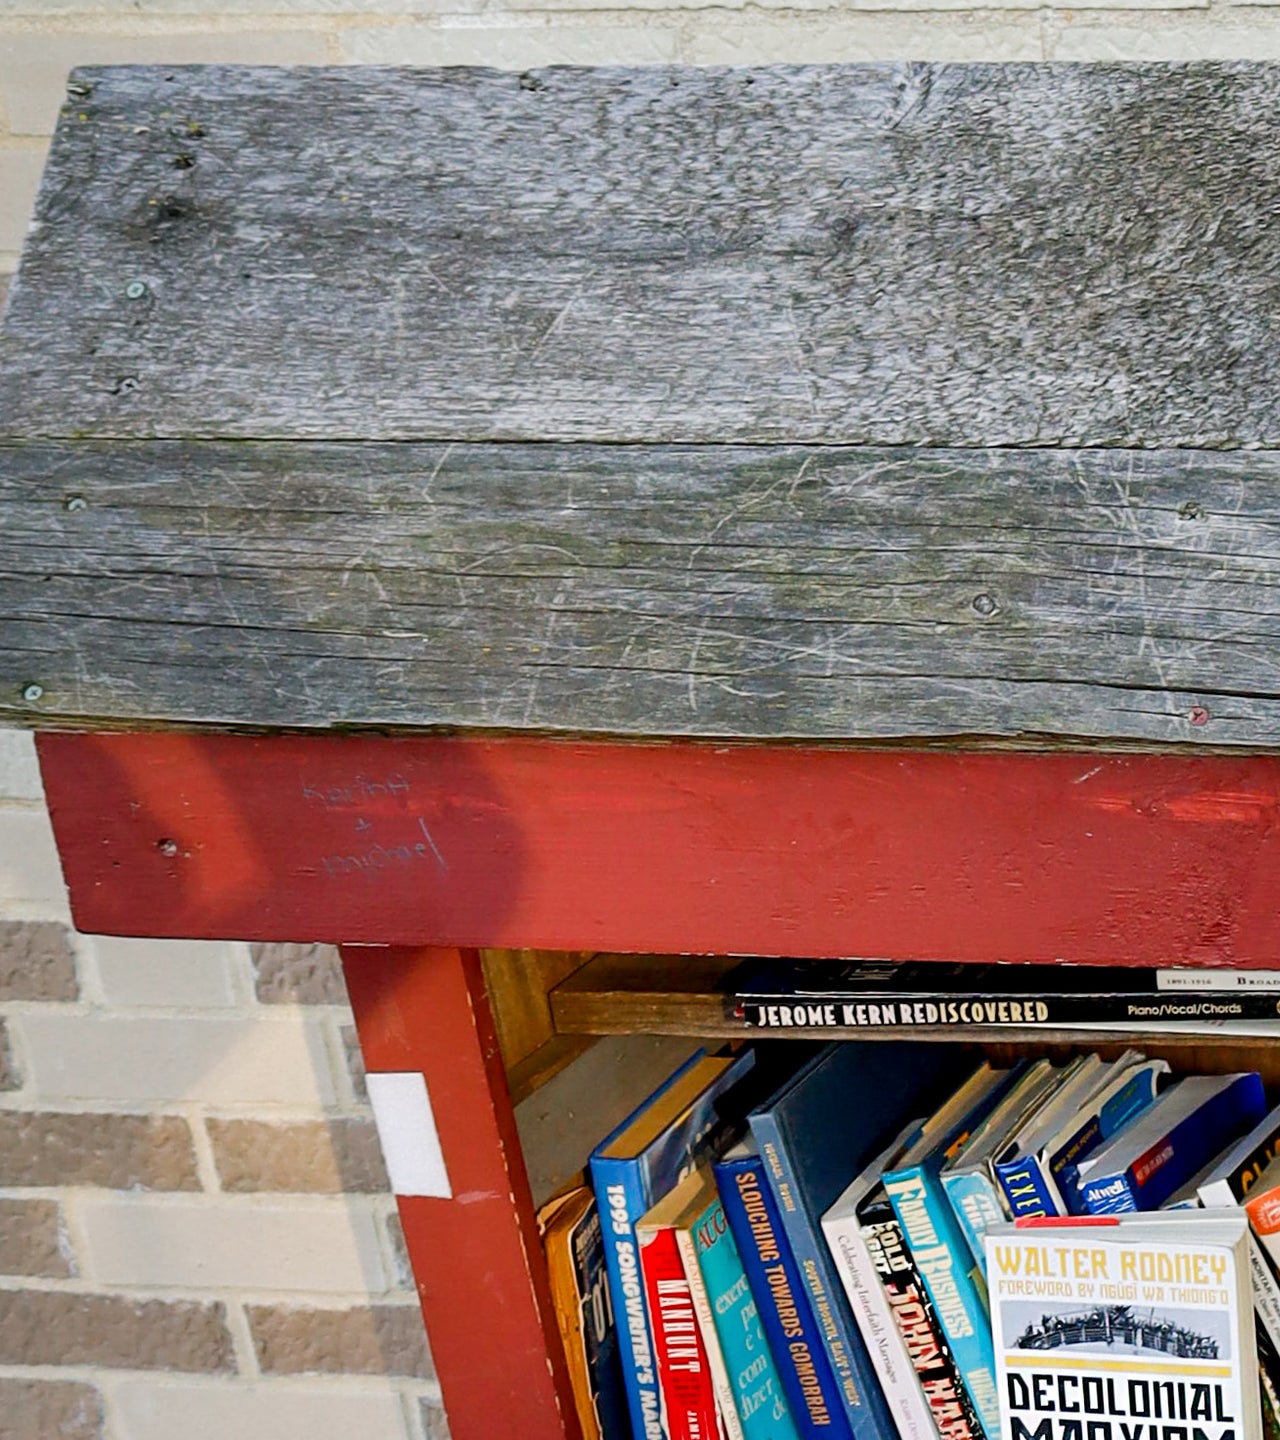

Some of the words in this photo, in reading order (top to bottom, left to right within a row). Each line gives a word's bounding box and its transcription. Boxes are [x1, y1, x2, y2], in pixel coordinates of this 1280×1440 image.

[757, 1005, 836, 1026] JEROME
[842, 1004, 896, 1025] KERN
[899, 1002, 1048, 1024] REDISCOVERED
[1127, 1002, 1242, 1017] Piano/Vocal/Chords
[605, 1183, 631, 1235] 1995
[612, 1239, 657, 1386] SONGWRITER'S
[734, 1169, 782, 1264] SLOUCHING
[764, 1263, 804, 1339] TOWARDS
[787, 1339, 831, 1429] GOMORRAH
[834, 1232, 867, 1290] Celebrating
[855, 1287, 886, 1338] Interfaith
[912, 1241, 979, 1345] BUSINESS
[996, 1246, 1107, 1282] WALTER
[1120, 1250, 1228, 1286] RODNEY
[998, 1279, 1074, 1297] FOREWORD
[1077, 1282, 1095, 1298] BY
[1143, 1286, 1165, 1303] WA
[1169, 1287, 1230, 1306] THIONG'O
[656, 1278, 702, 1373] MANHUNT
[883, 1277, 944, 1377] JOHN
[1006, 1372, 1235, 1423] DECOLONIAL
